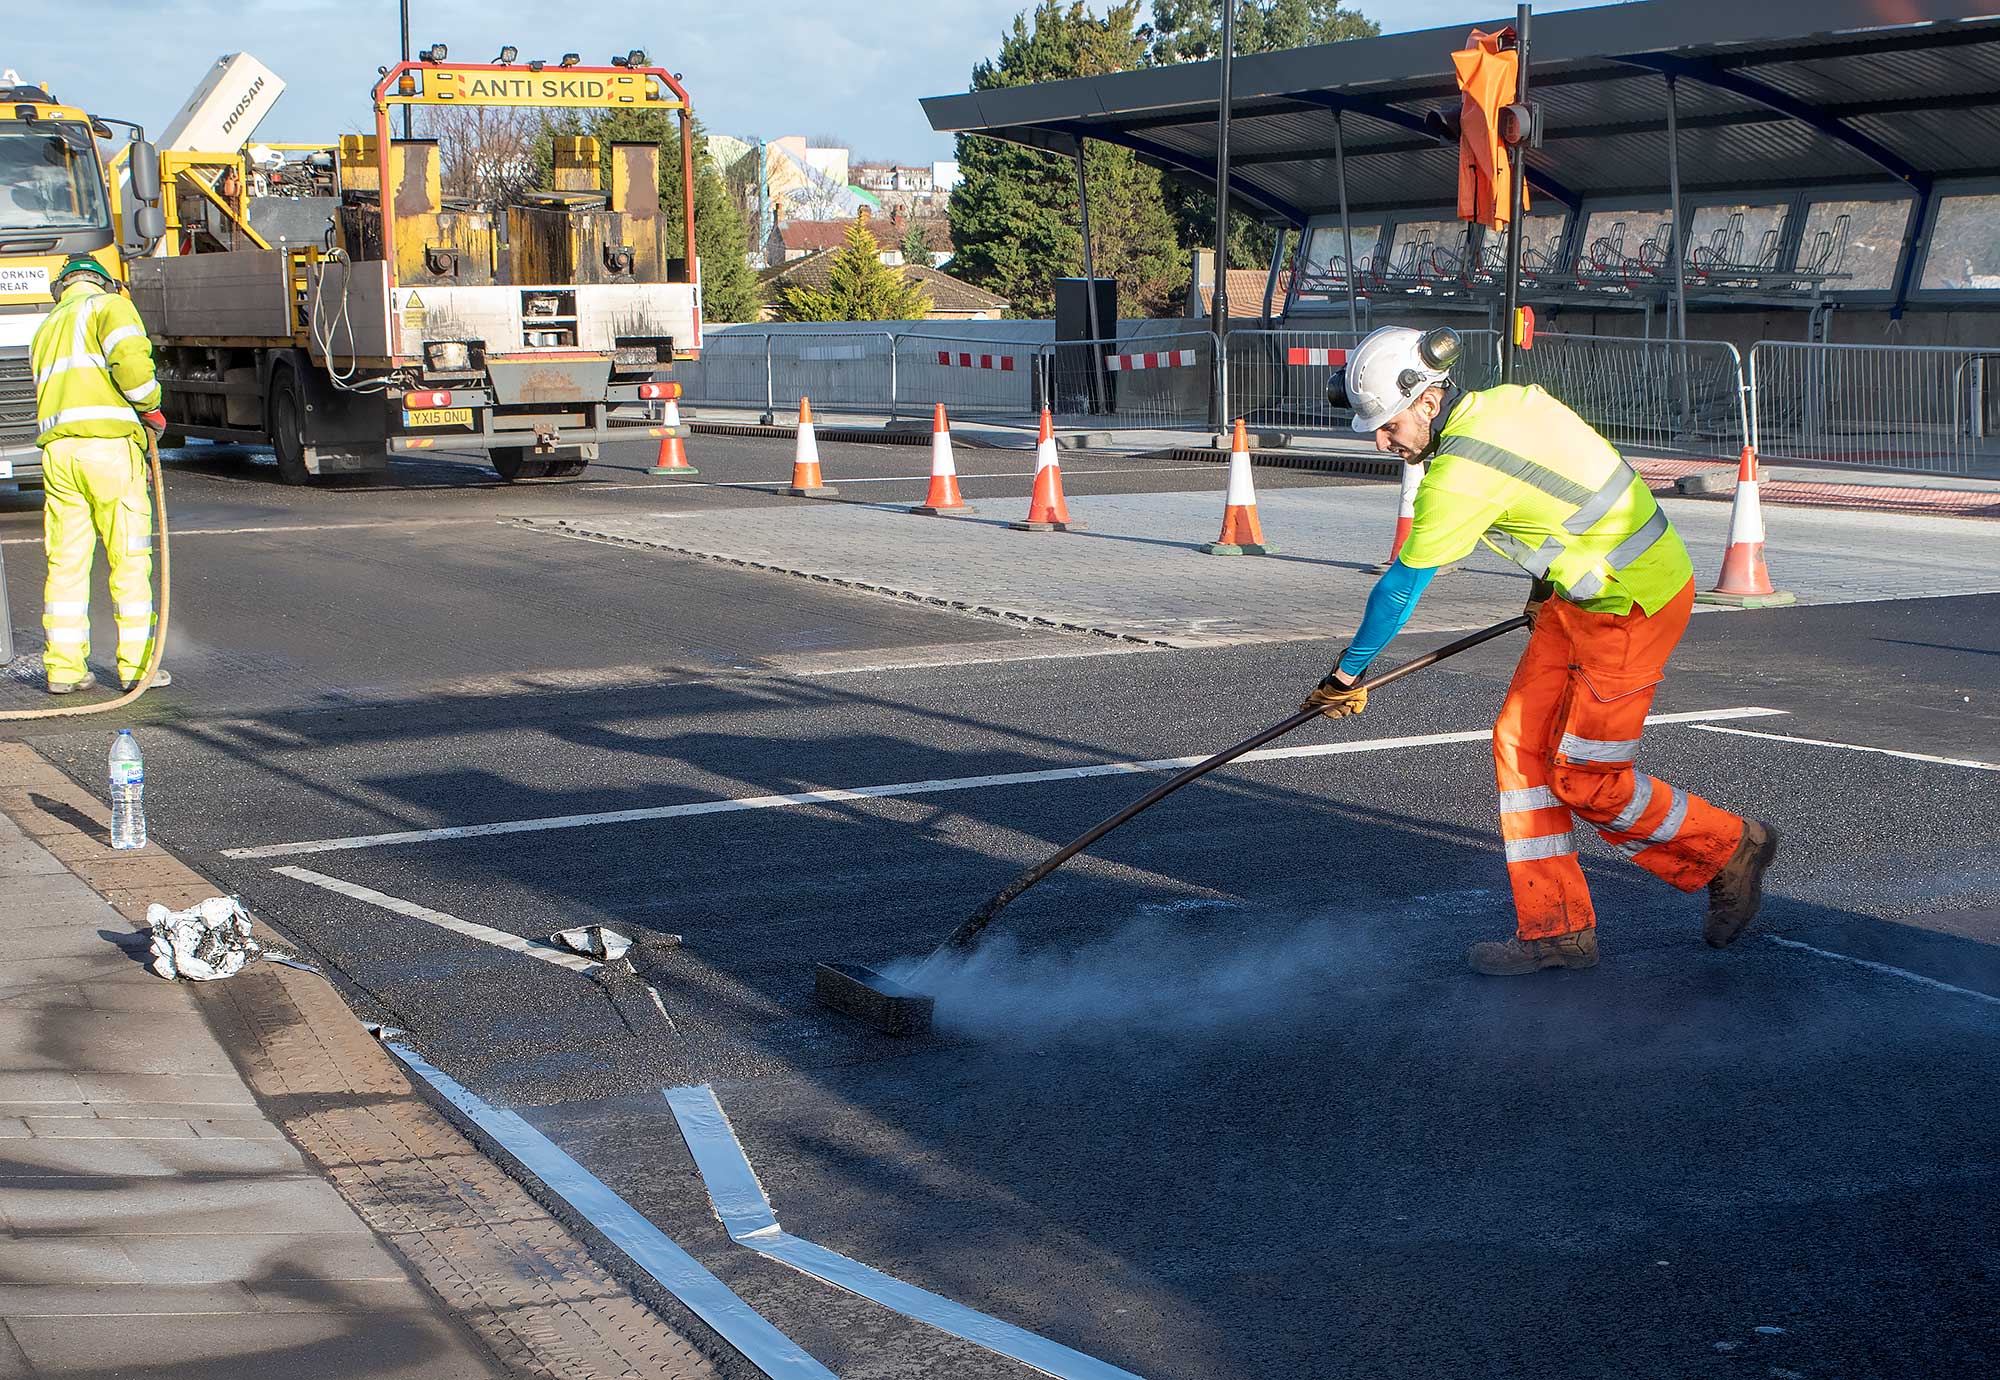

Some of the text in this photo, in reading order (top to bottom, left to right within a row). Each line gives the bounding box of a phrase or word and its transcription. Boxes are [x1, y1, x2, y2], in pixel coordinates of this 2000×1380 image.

[470, 79, 604, 98] ANTI SKID
[222, 76, 264, 135] DOOSAN
[0, 270, 45, 279] ORKING
[0, 282, 29, 291] REAR
[413, 411, 441, 425] YX15
